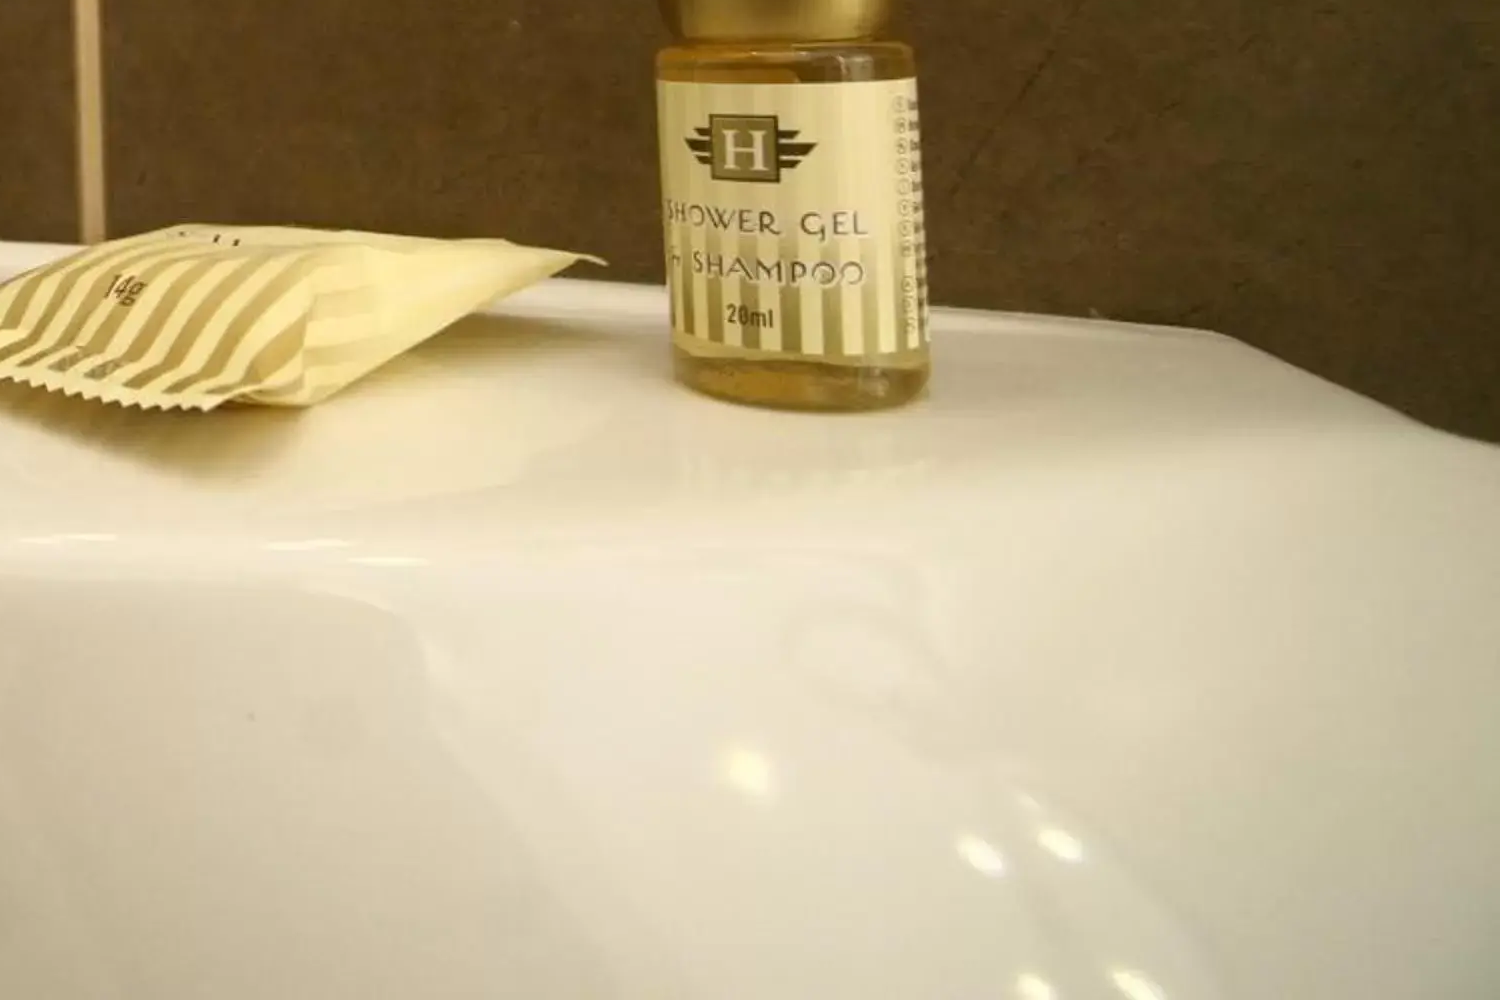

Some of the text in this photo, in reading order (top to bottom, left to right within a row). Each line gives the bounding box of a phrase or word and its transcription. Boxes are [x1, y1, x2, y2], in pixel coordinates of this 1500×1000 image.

[723, 130, 769, 171] H
[666, 199, 869, 241] SHOWER GEL
[693, 250, 864, 285] SHAMPOO
[104, 274, 148, 307] 14g
[726, 304, 773, 328] 20ml
